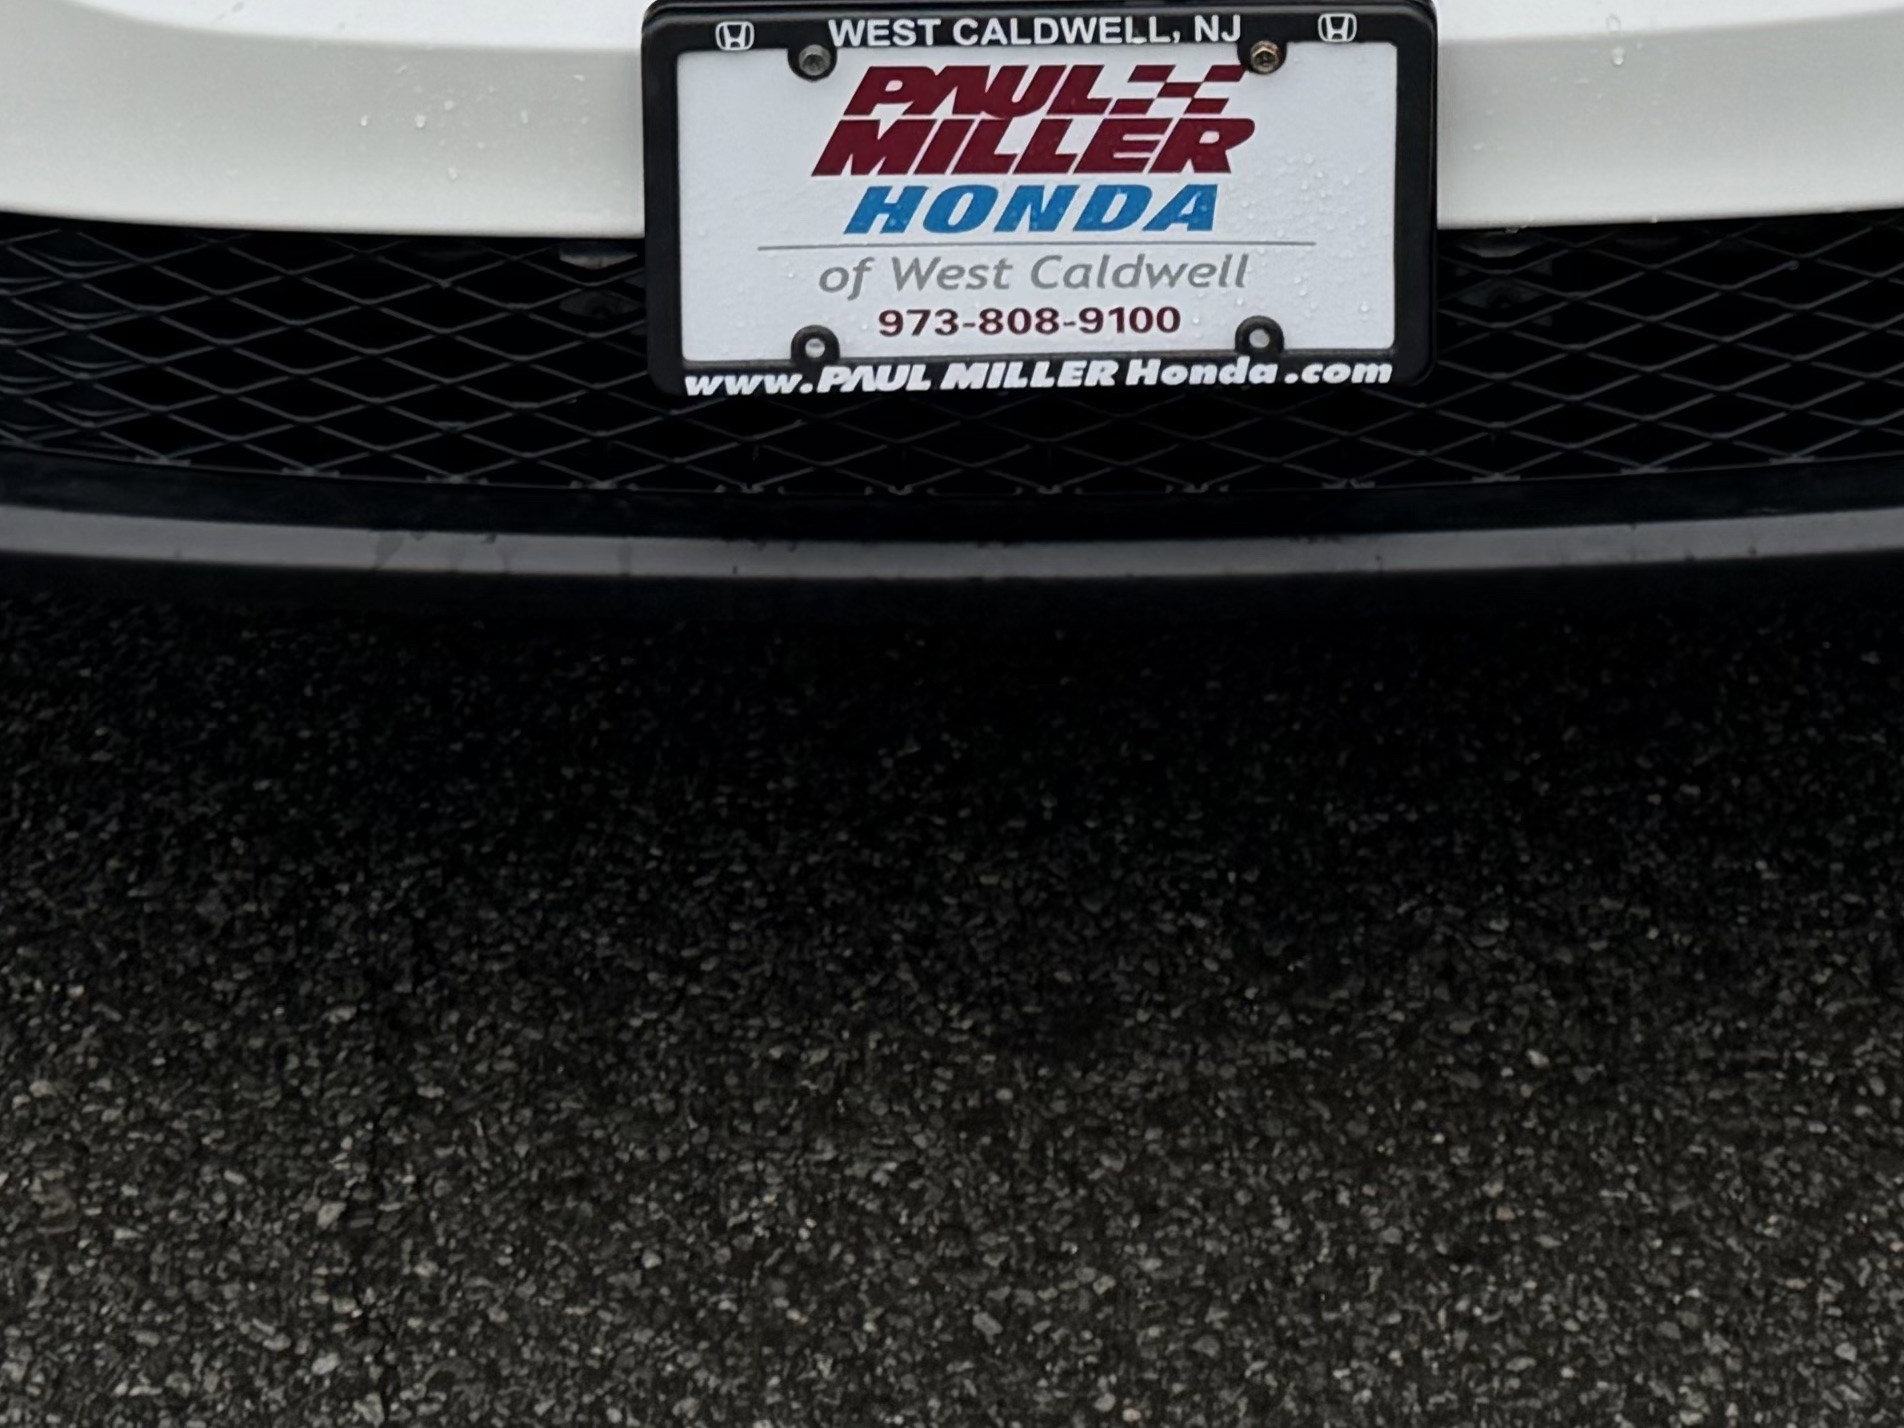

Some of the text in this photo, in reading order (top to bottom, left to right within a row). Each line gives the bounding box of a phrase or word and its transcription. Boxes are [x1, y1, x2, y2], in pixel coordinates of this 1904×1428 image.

[828, 14, 1242, 47] WEST CALDWELL, NJ
[842, 64, 1112, 119] PAUL
[811, 117, 1256, 177] MILLER
[843, 182, 1219, 235] HONDA
[818, 252, 1250, 301] of West Caldwell
[877, 305, 1182, 338] 973-808-9100
[940, 359, 1120, 391] MILLER
